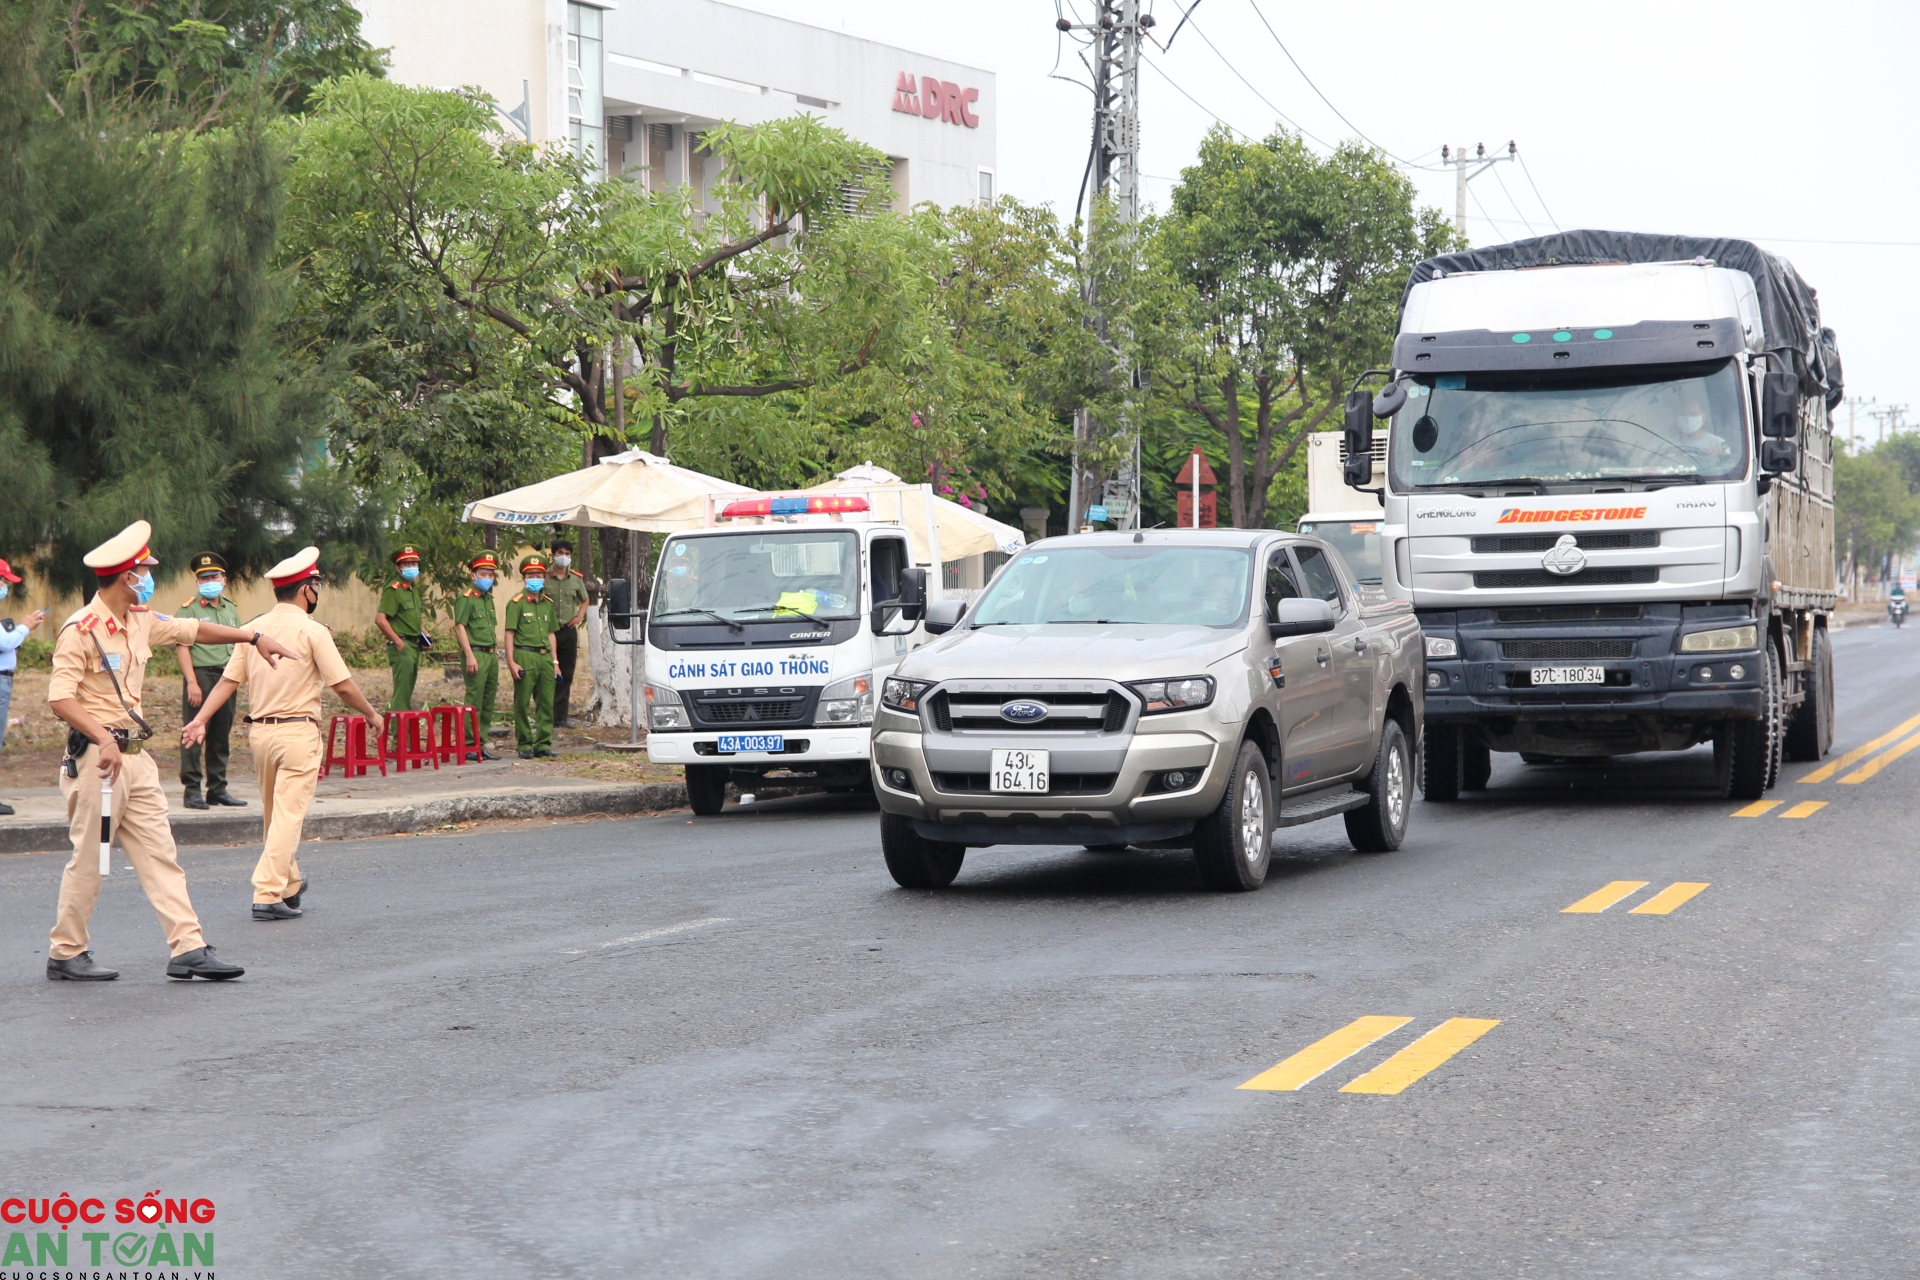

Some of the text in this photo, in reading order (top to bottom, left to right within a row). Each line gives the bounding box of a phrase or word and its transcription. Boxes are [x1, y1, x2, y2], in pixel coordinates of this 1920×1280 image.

[922, 76, 979, 129] DRC
[1416, 506, 1477, 519] CHENGLONG
[1495, 506, 1647, 524] BRIDGESTONE
[789, 631, 832, 639] CANTER
[669, 657, 829, 678] CẢNH SÁT GIAO THÔNG
[703, 687, 796, 696] FUSO
[1010, 705, 1036, 717] Ford
[720, 736, 781, 750] 43A-003.97
[1005, 751, 1035, 770] 43C
[995, 771, 1047, 790] 164.16
